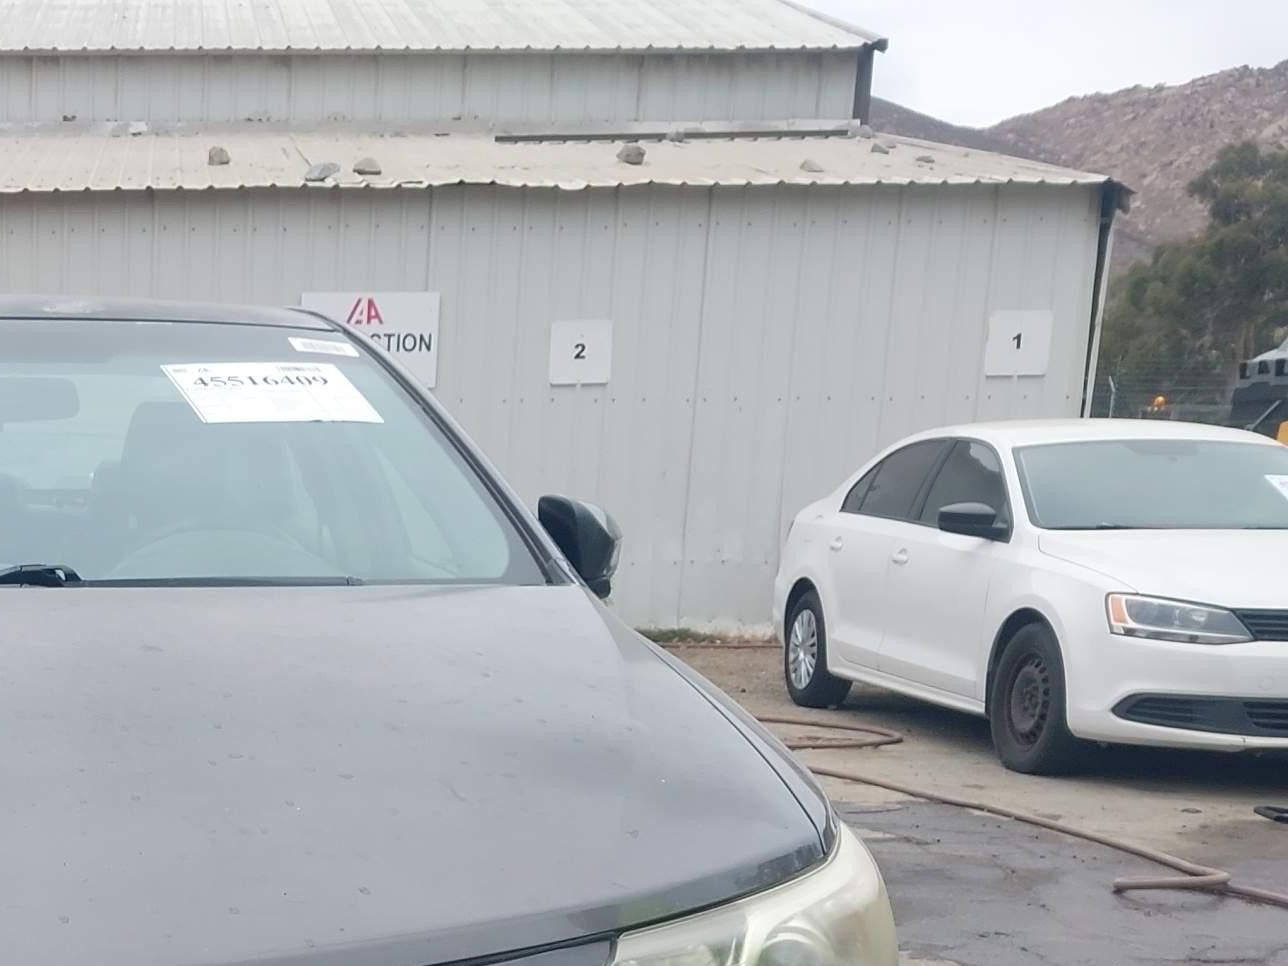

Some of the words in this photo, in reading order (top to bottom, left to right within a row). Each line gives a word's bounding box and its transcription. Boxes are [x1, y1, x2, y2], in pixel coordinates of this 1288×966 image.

[1012, 332, 1022, 350] 1
[574, 343, 586, 360] 2
[193, 375, 329, 387] 45516409
